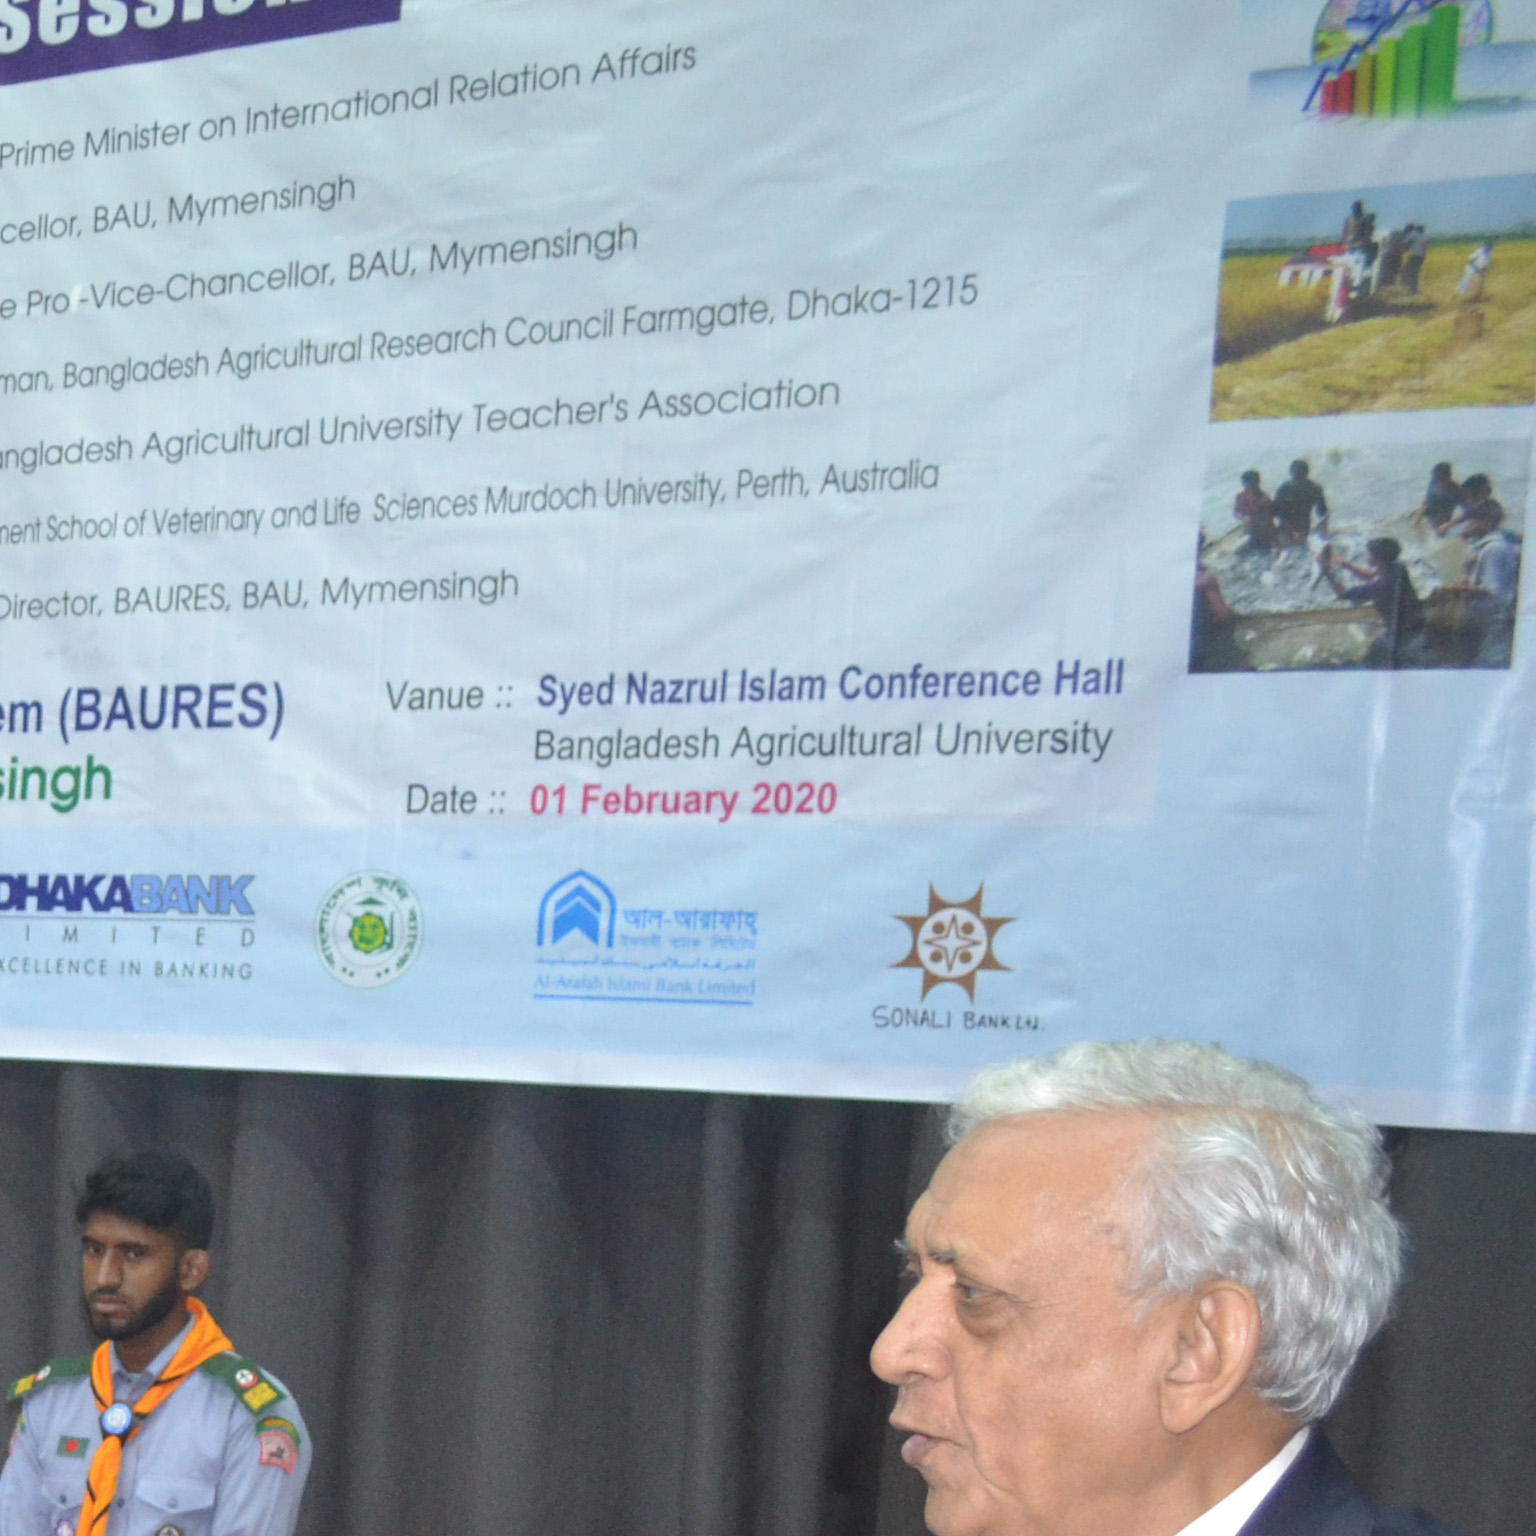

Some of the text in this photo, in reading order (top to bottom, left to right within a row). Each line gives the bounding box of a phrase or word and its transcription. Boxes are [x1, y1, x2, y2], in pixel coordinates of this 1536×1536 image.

[83, 120, 192, 158] Minister
[198, 115, 237, 142] on
[245, 77, 439, 135] International
[449, 62, 581, 105] Relation
[590, 42, 697, 84] Affairs
[92, 199, 158, 234] BAU,
[167, 173, 356, 227] Mymensingh
[347, 246, 417, 283] BAU,
[429, 220, 638, 276] Mymensingh
[62, 349, 210, 393] Bangladesh
[216, 333, 363, 381] Agricultural
[369, 320, 497, 361] Research
[504, 307, 615, 348] Council
[622, 294, 775, 338] Farmgate,
[787, 272, 979, 321] Dhaka-1215
[141, 418, 311, 465] Agricultural
[319, 407, 463, 446] University
[472, 392, 629, 434] Teacher's
[637, 378, 841, 421] Association
[45, 511, 119, 543] School
[123, 508, 148, 538] of
[151, 505, 266, 537] Veterinary
[270, 498, 318, 530] and
[322, 495, 362, 527] Life
[372, 491, 479, 523] Sciences
[484, 479, 597, 515] Murdoch
[604, 471, 727, 509] University,
[735, 466, 810, 501] Perth,
[819, 457, 941, 495] Australia
[113, 582, 231, 615] BAURES,
[242, 578, 309, 611] BAU,
[320, 567, 520, 611] Mymensingh
[59, 684, 285, 745] (BAURES)
[385, 680, 485, 712] Vanue
[537, 671, 616, 716] Syed
[625, 668, 729, 705] Nazrul
[738, 667, 827, 703] Islam
[838, 662, 1042, 701] Conference
[1054, 657, 1125, 696] Hall
[534, 719, 1114, 769] Bangladesh Agricultural University
[405, 782, 478, 815] Date
[530, 783, 566, 816] 01
[580, 783, 740, 824] February
[750, 781, 838, 816] 2020
[119, 960, 142, 977] IN
[153, 960, 254, 981] BANKING
[872, 1005, 953, 1029] SONALI
